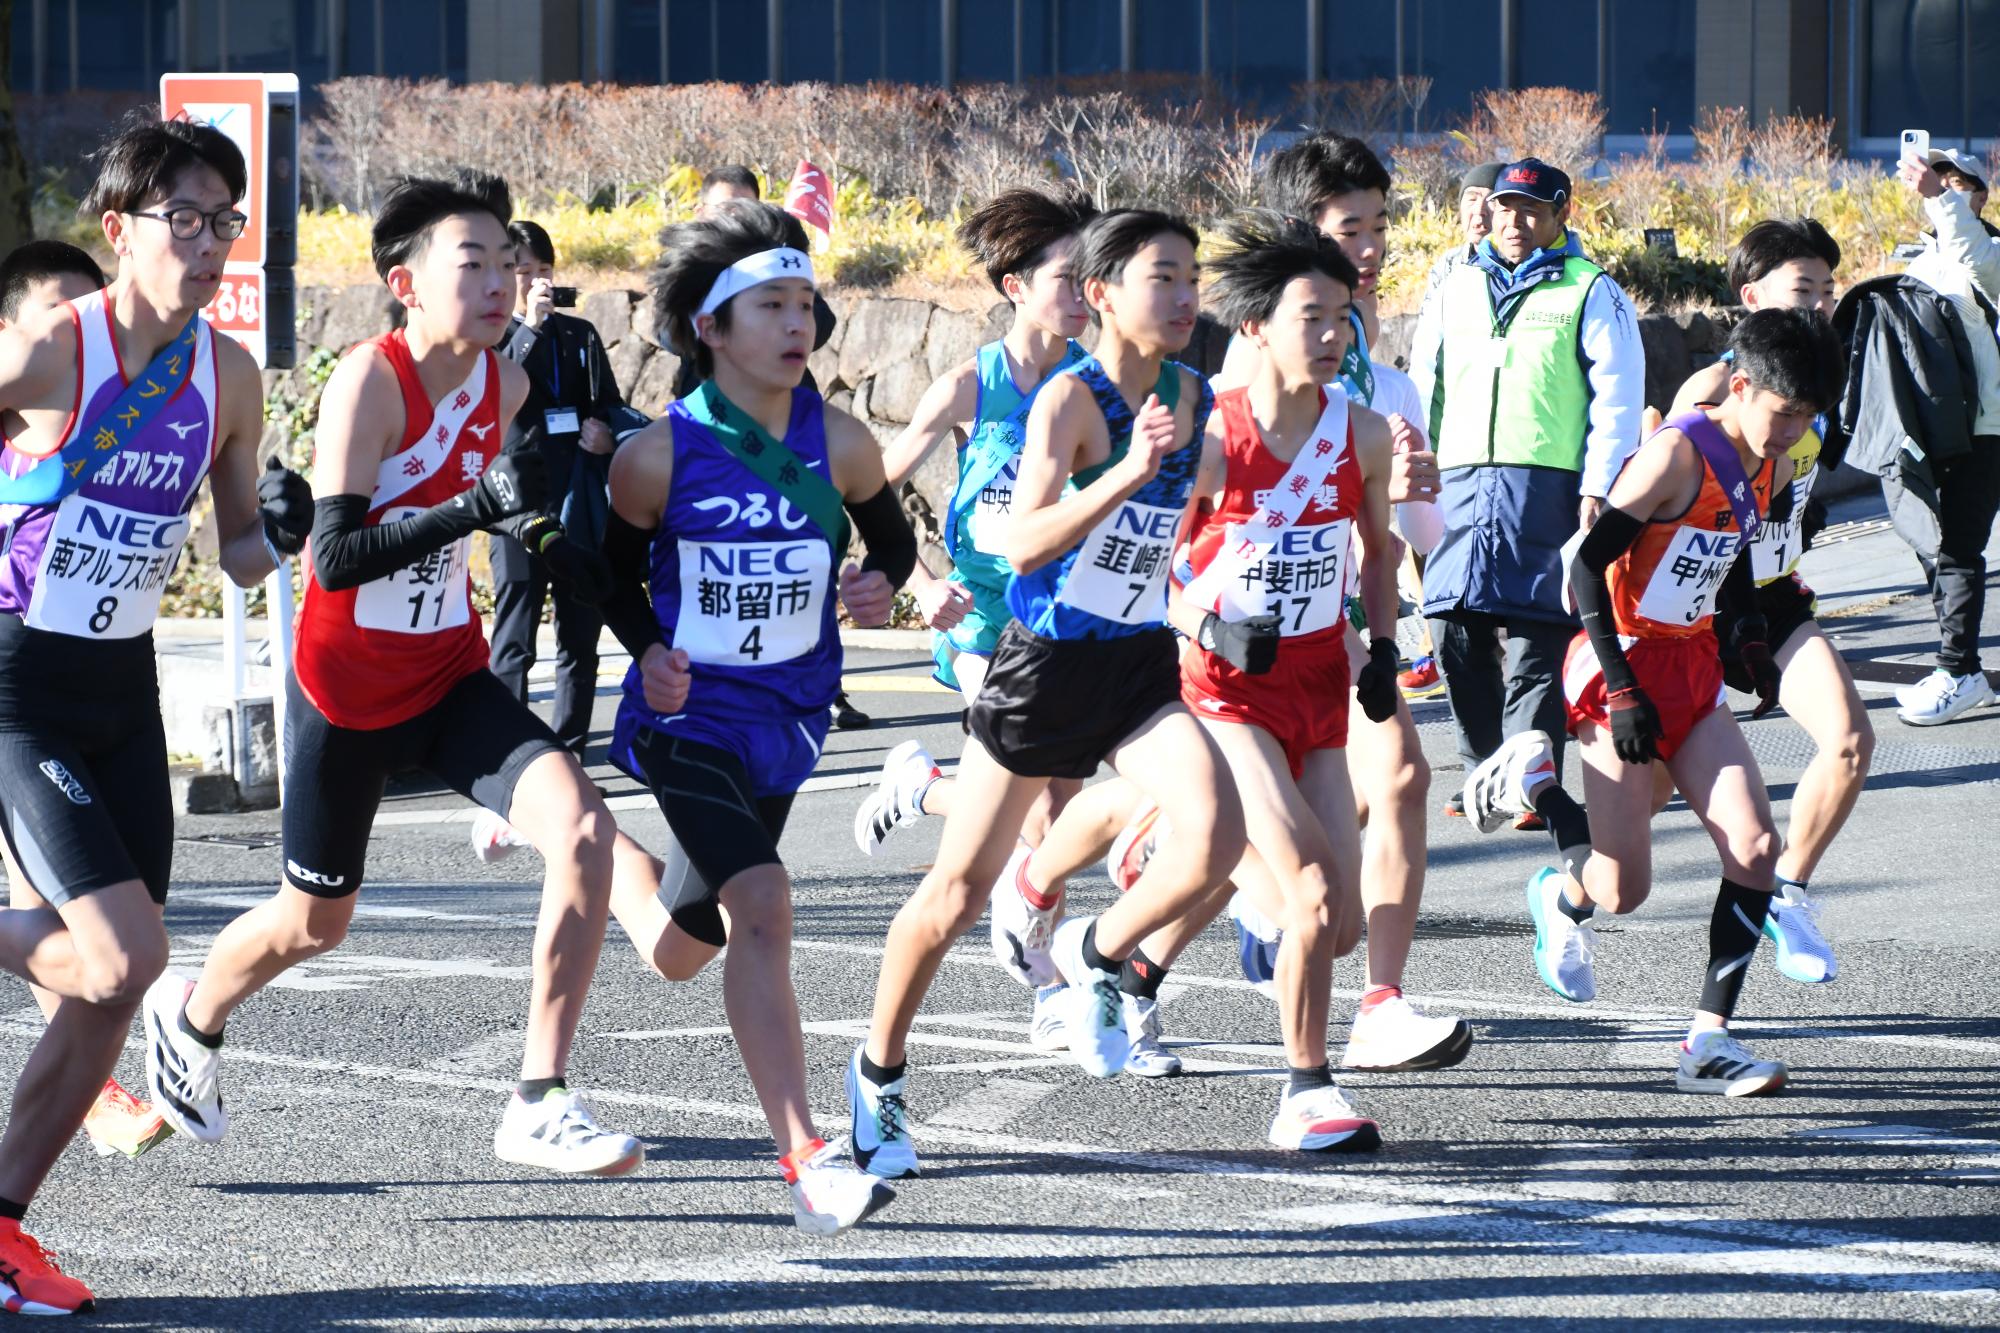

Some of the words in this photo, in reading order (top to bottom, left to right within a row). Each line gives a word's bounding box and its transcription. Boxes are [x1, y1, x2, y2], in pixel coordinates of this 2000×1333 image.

[373, 389, 471, 492] 甲斐市
[92, 450, 185, 492] 南アルプス
[982, 484, 1013, 515] 中央
[1236, 437, 1334, 560] 甲斐市B
[1732, 480, 1757, 533] 甲州
[76, 504, 183, 549] NEC
[1268, 525, 1339, 556] EC
[46, 536, 173, 592] 南アルプス市A
[388, 539, 464, 587] 斐市A
[700, 544, 809, 577] NEC
[1774, 543, 1787, 573] 1
[88, 594, 119, 634] 8
[407, 588, 446, 629] 11
[697, 577, 813, 622] 都留市
[1121, 582, 1147, 618] 7
[1266, 596, 1313, 632] 17
[1685, 593, 1707, 623] 3
[738, 624, 764, 661] 4
